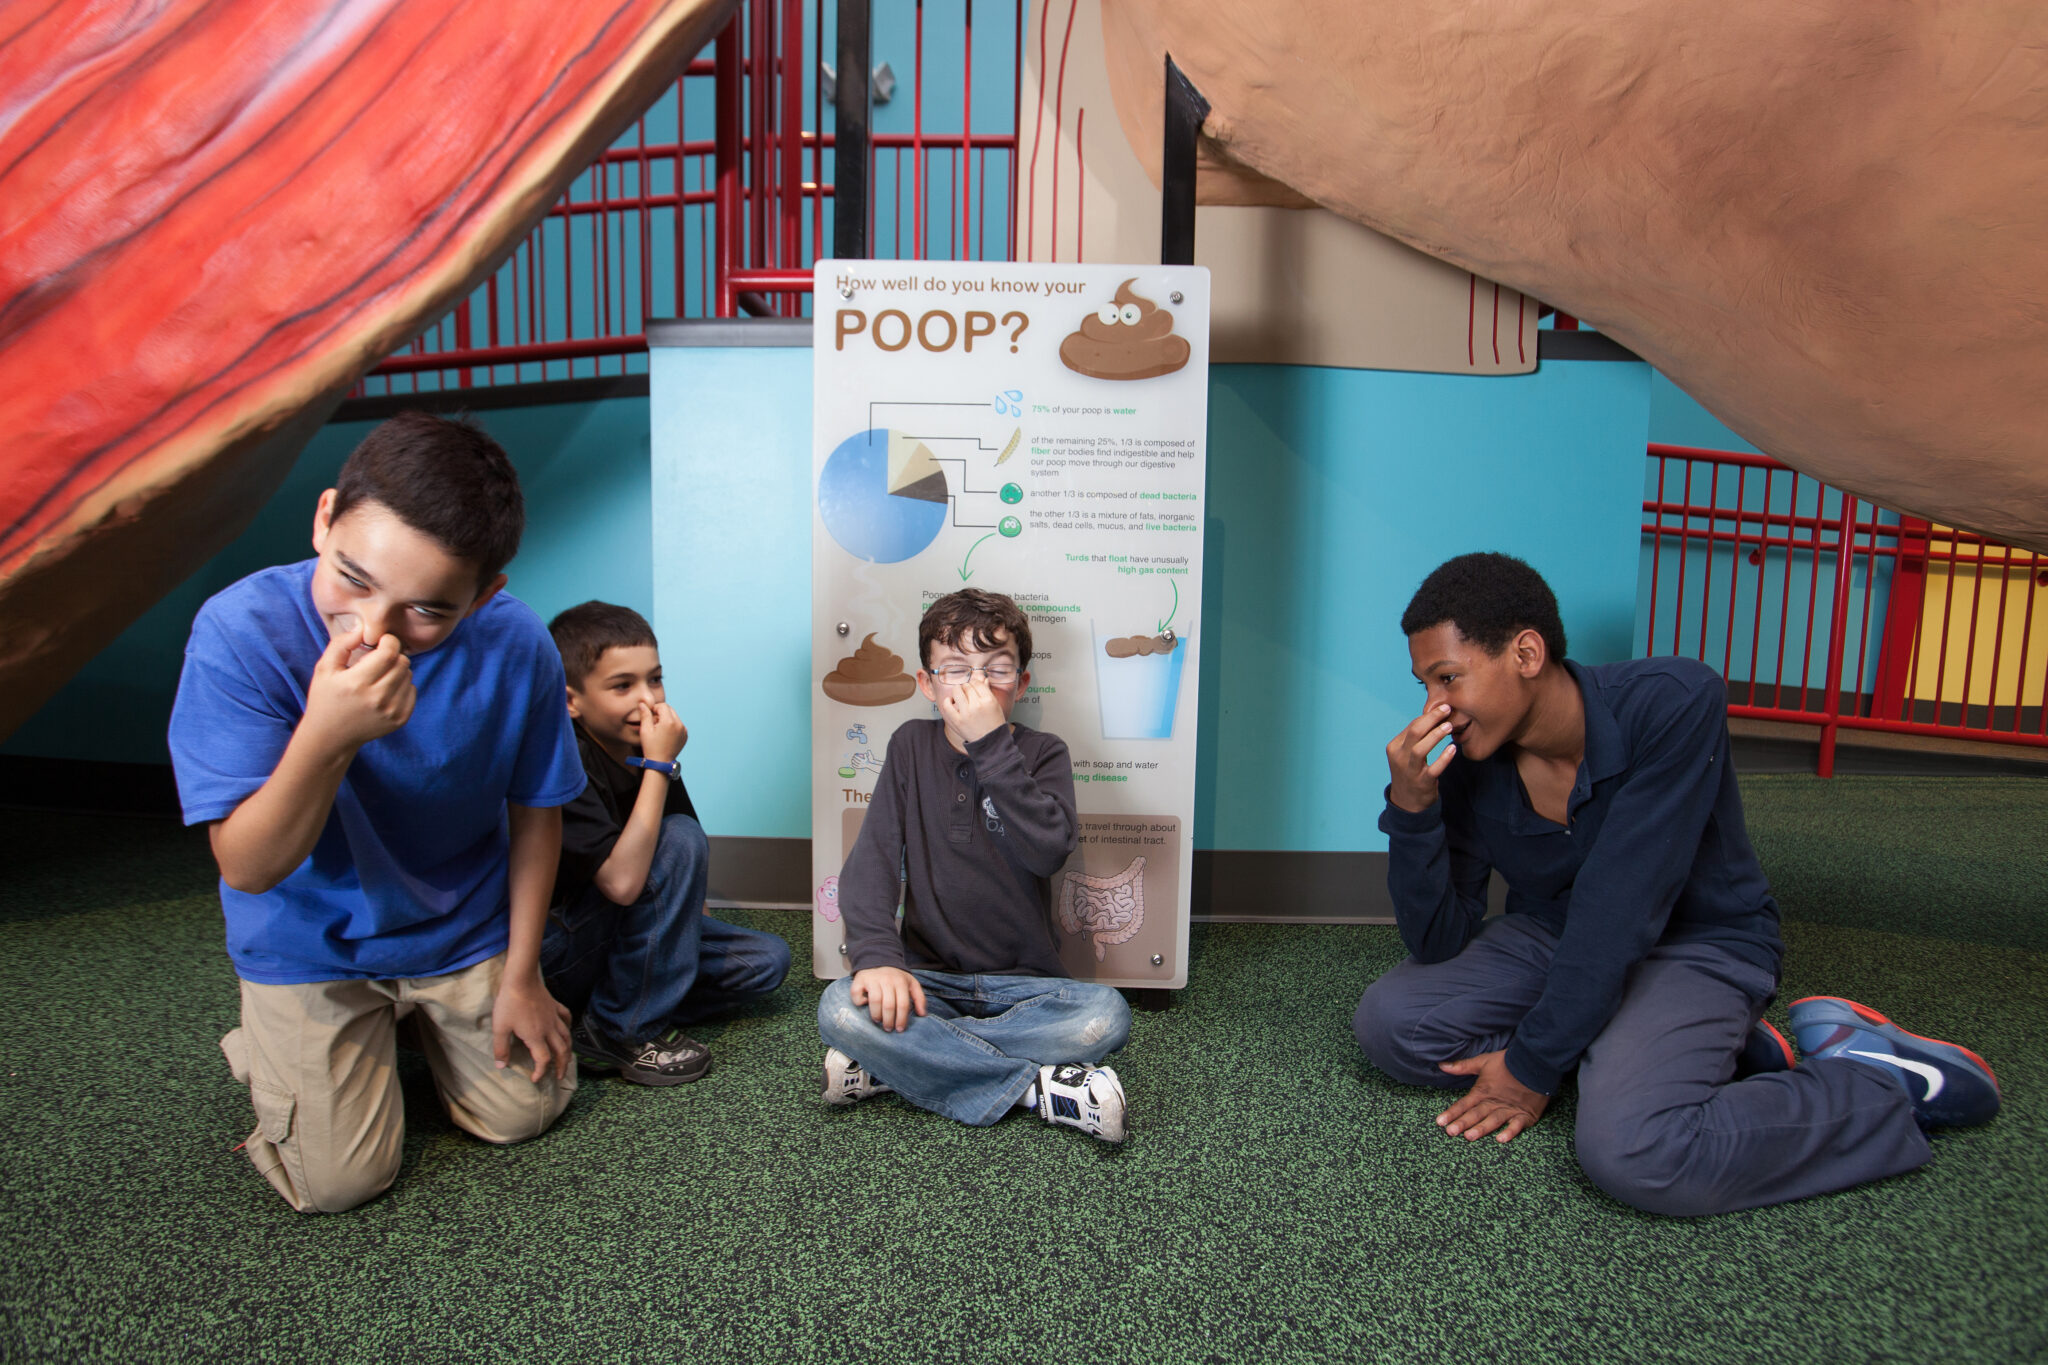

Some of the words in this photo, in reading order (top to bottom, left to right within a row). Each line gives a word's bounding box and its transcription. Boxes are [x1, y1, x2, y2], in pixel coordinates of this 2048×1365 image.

[835, 275, 877, 291] How
[882, 276, 918, 291] well
[923, 277, 947, 292] do
[951, 280, 985, 295] you
[990, 278, 1040, 294] know
[1043, 281, 1087, 297] your
[835, 308, 1030, 353] POOP?
[1031, 405, 1050, 413] 75%
[1052, 406, 1060, 414] of
[1062, 407, 1080, 415] your
[1081, 407, 1102, 415] poop
[1104, 406, 1111, 415] is
[1113, 407, 1137, 415] water
[1056, 437, 1096, 446] remaining
[1121, 438, 1133, 446] 1/3
[1143, 439, 1185, 448] composed
[1187, 439, 1195, 447] of
[1031, 446, 1051, 455] fiber
[1068, 448, 1095, 456] bodies
[1096, 448, 1112, 457] find
[1113, 449, 1158, 458] indigestible
[1160, 450, 1176, 458] and
[1177, 450, 1195, 459] help
[1046, 459, 1067, 467] poop
[1092, 459, 1123, 468] through
[1140, 460, 1176, 469] digestive
[1030, 469, 1060, 478] system
[1030, 490, 1061, 498] another
[1063, 490, 1076, 498] 1/3
[1077, 490, 1085, 499] is
[1086, 491, 1128, 500] composed
[1129, 491, 1138, 500] of
[1139, 492, 1161, 500] dead
[1162, 492, 1197, 501] bacteria
[1029, 510, 1043, 518] the
[1044, 510, 1065, 518] other
[1068, 511, 1080, 519] 1/3
[1081, 511, 1089, 519] is
[1098, 512, 1128, 520] mixture
[1129, 512, 1138, 520] of
[1139, 512, 1156, 521] fats,
[1158, 513, 1195, 522] inorganic
[1029, 521, 1051, 529] salts,
[1052, 521, 1073, 529] dead
[1074, 522, 1095, 530] cells,
[1097, 523, 1126, 532] mucus,
[1128, 523, 1144, 531] and
[1145, 523, 1161, 531] live
[1162, 523, 1197, 532] bacteria
[1065, 554, 1090, 562] Turds
[1091, 554, 1107, 562] that
[1108, 554, 1128, 563] float
[1129, 555, 1149, 564] have
[1151, 556, 1189, 566] unusually
[1118, 566, 1137, 576] high
[1138, 568, 1154, 576] gas
[1014, 592, 1049, 601] bacteria
[1025, 602, 1081, 613] compounds
[1031, 614, 1067, 624] nitrogen
[1031, 696, 1040, 704] of
[1073, 760, 1091, 768] with
[1092, 761, 1114, 770] soap
[1116, 761, 1133, 769] and
[1134, 761, 1159, 769] water
[1092, 773, 1128, 782] disease
[1085, 823, 1111, 831] travel
[1112, 823, 1148, 833] through
[1150, 823, 1176, 832] about
[1090, 835, 1099, 843] of
[1101, 835, 1141, 845] intestinal
[1143, 836, 1166, 845] tract.
